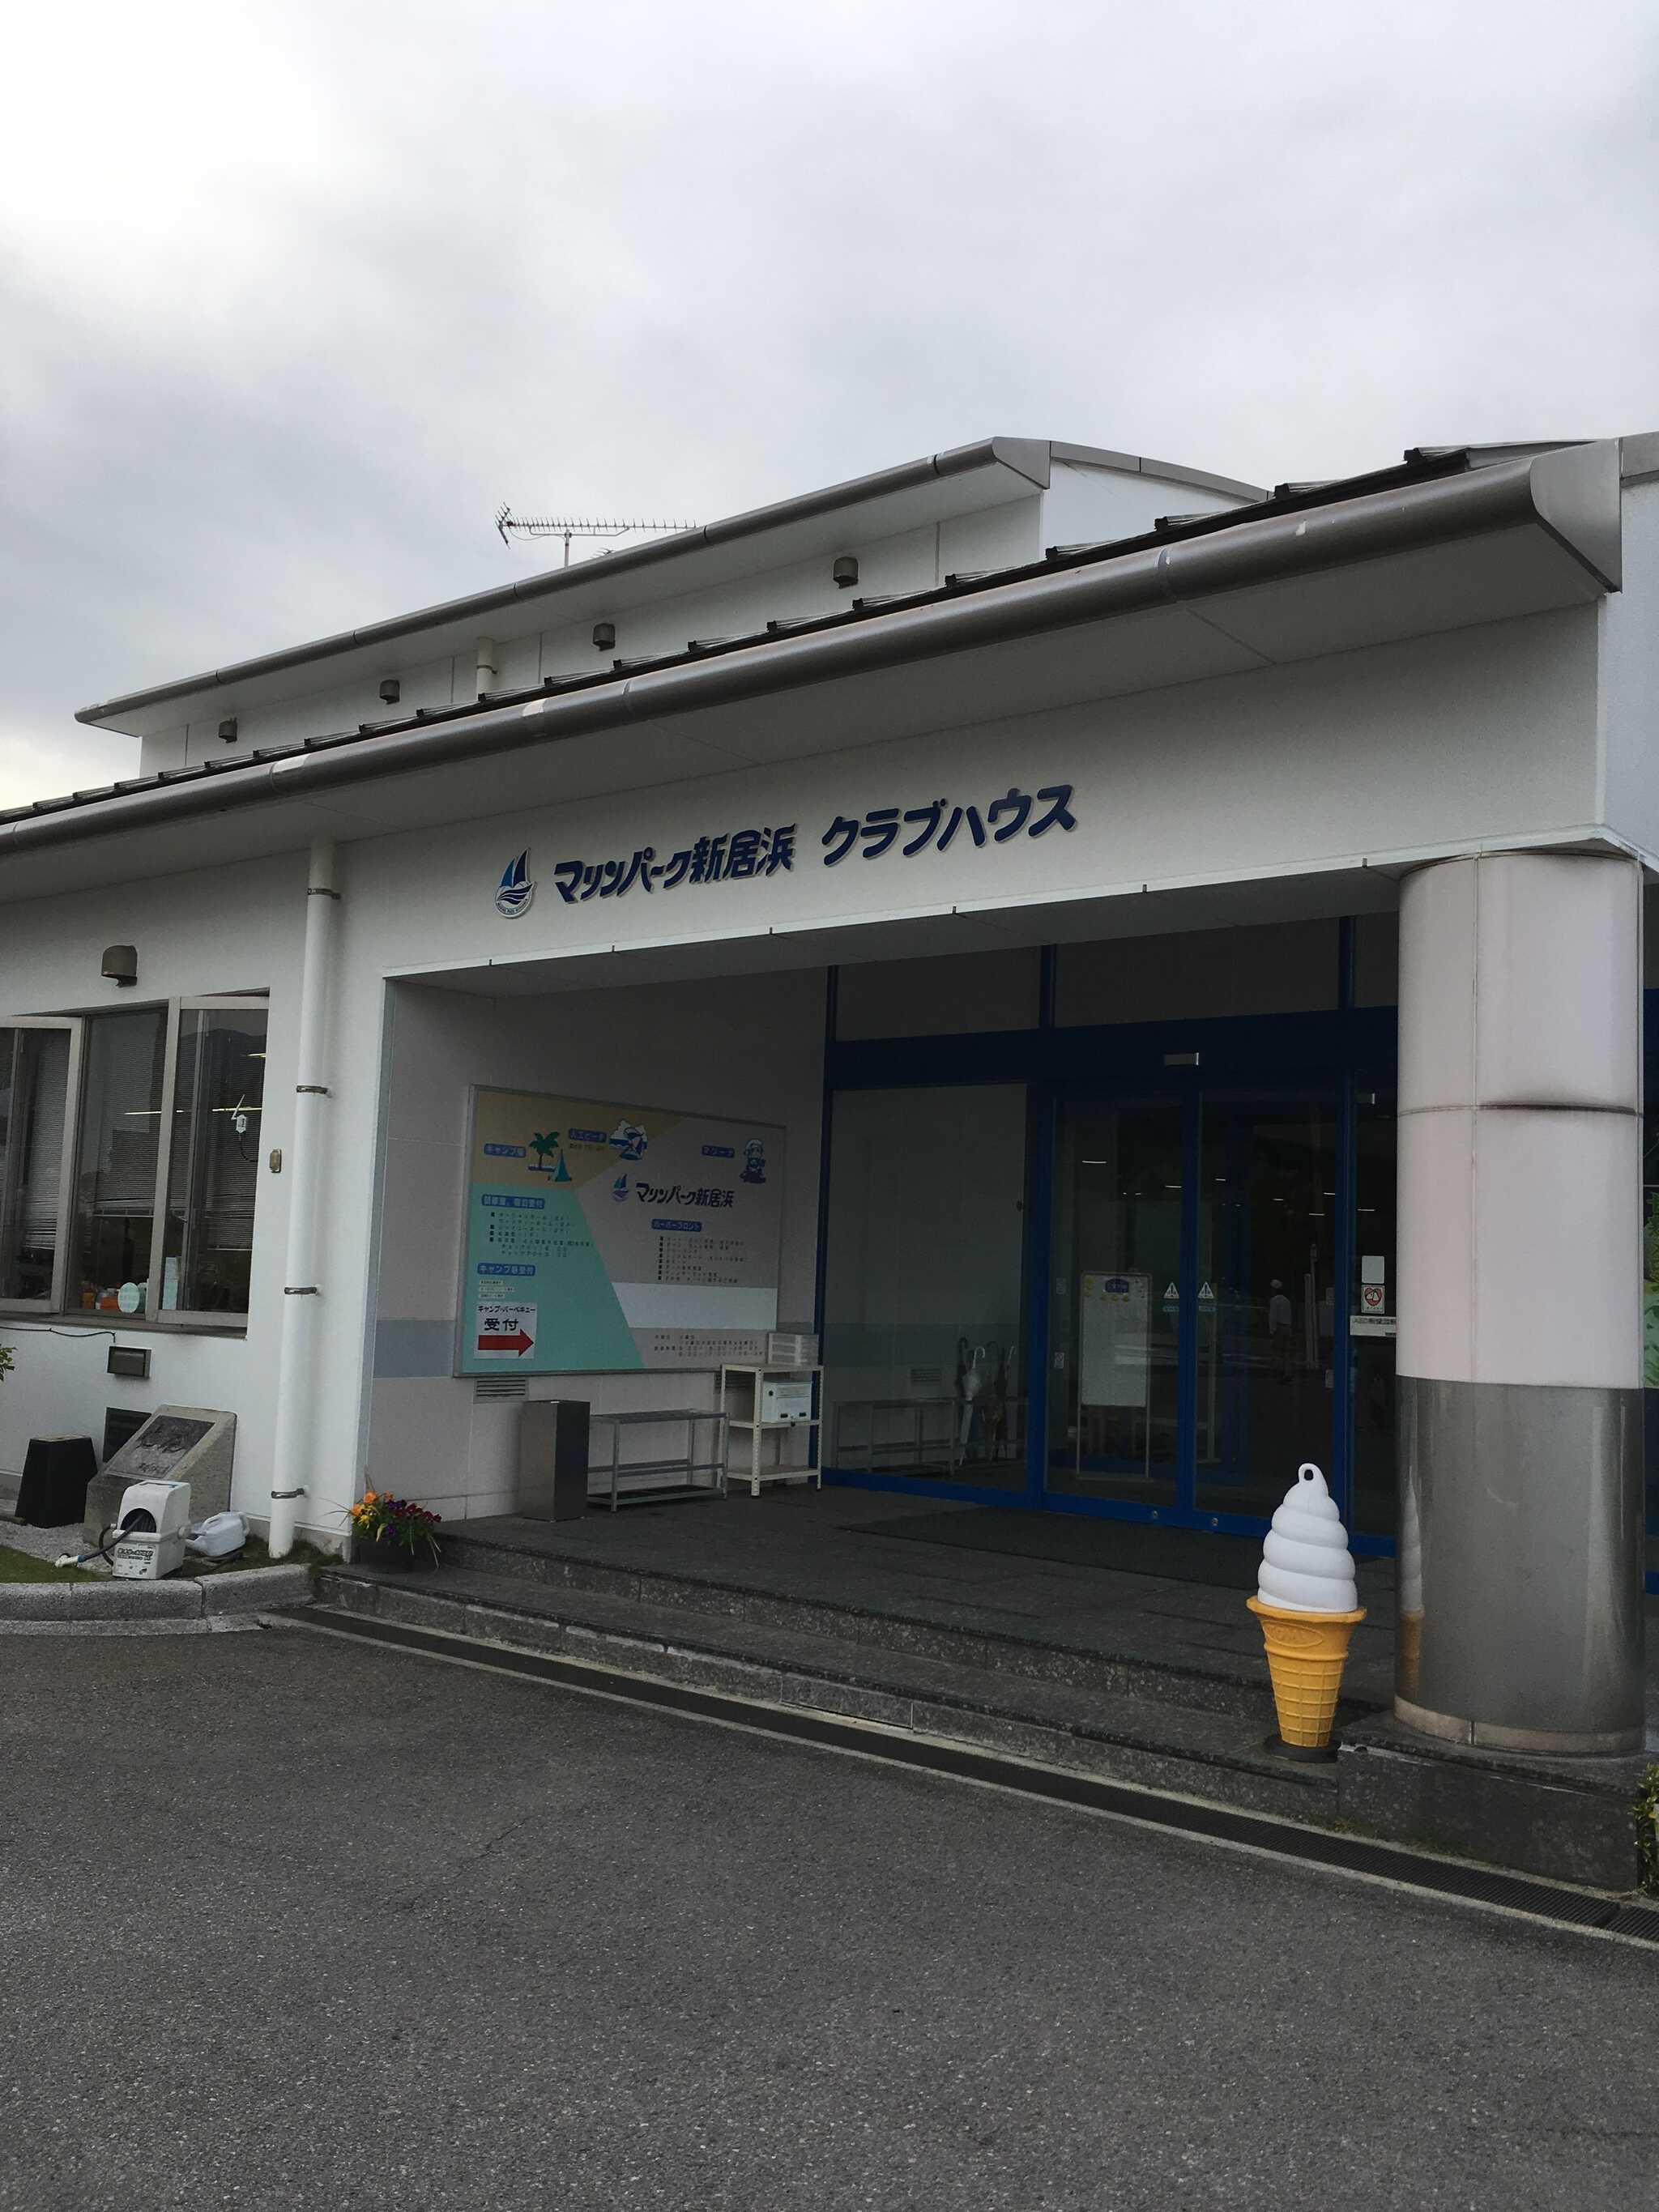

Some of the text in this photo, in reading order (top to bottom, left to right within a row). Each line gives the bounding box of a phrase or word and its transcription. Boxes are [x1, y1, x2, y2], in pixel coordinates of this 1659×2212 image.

[553, 783, 1077, 905] マリンパーク新居浜 クラブハウス
[635, 1182, 736, 1208] マリンパーク新居浜
[484, 1318, 519, 1332] 受付
